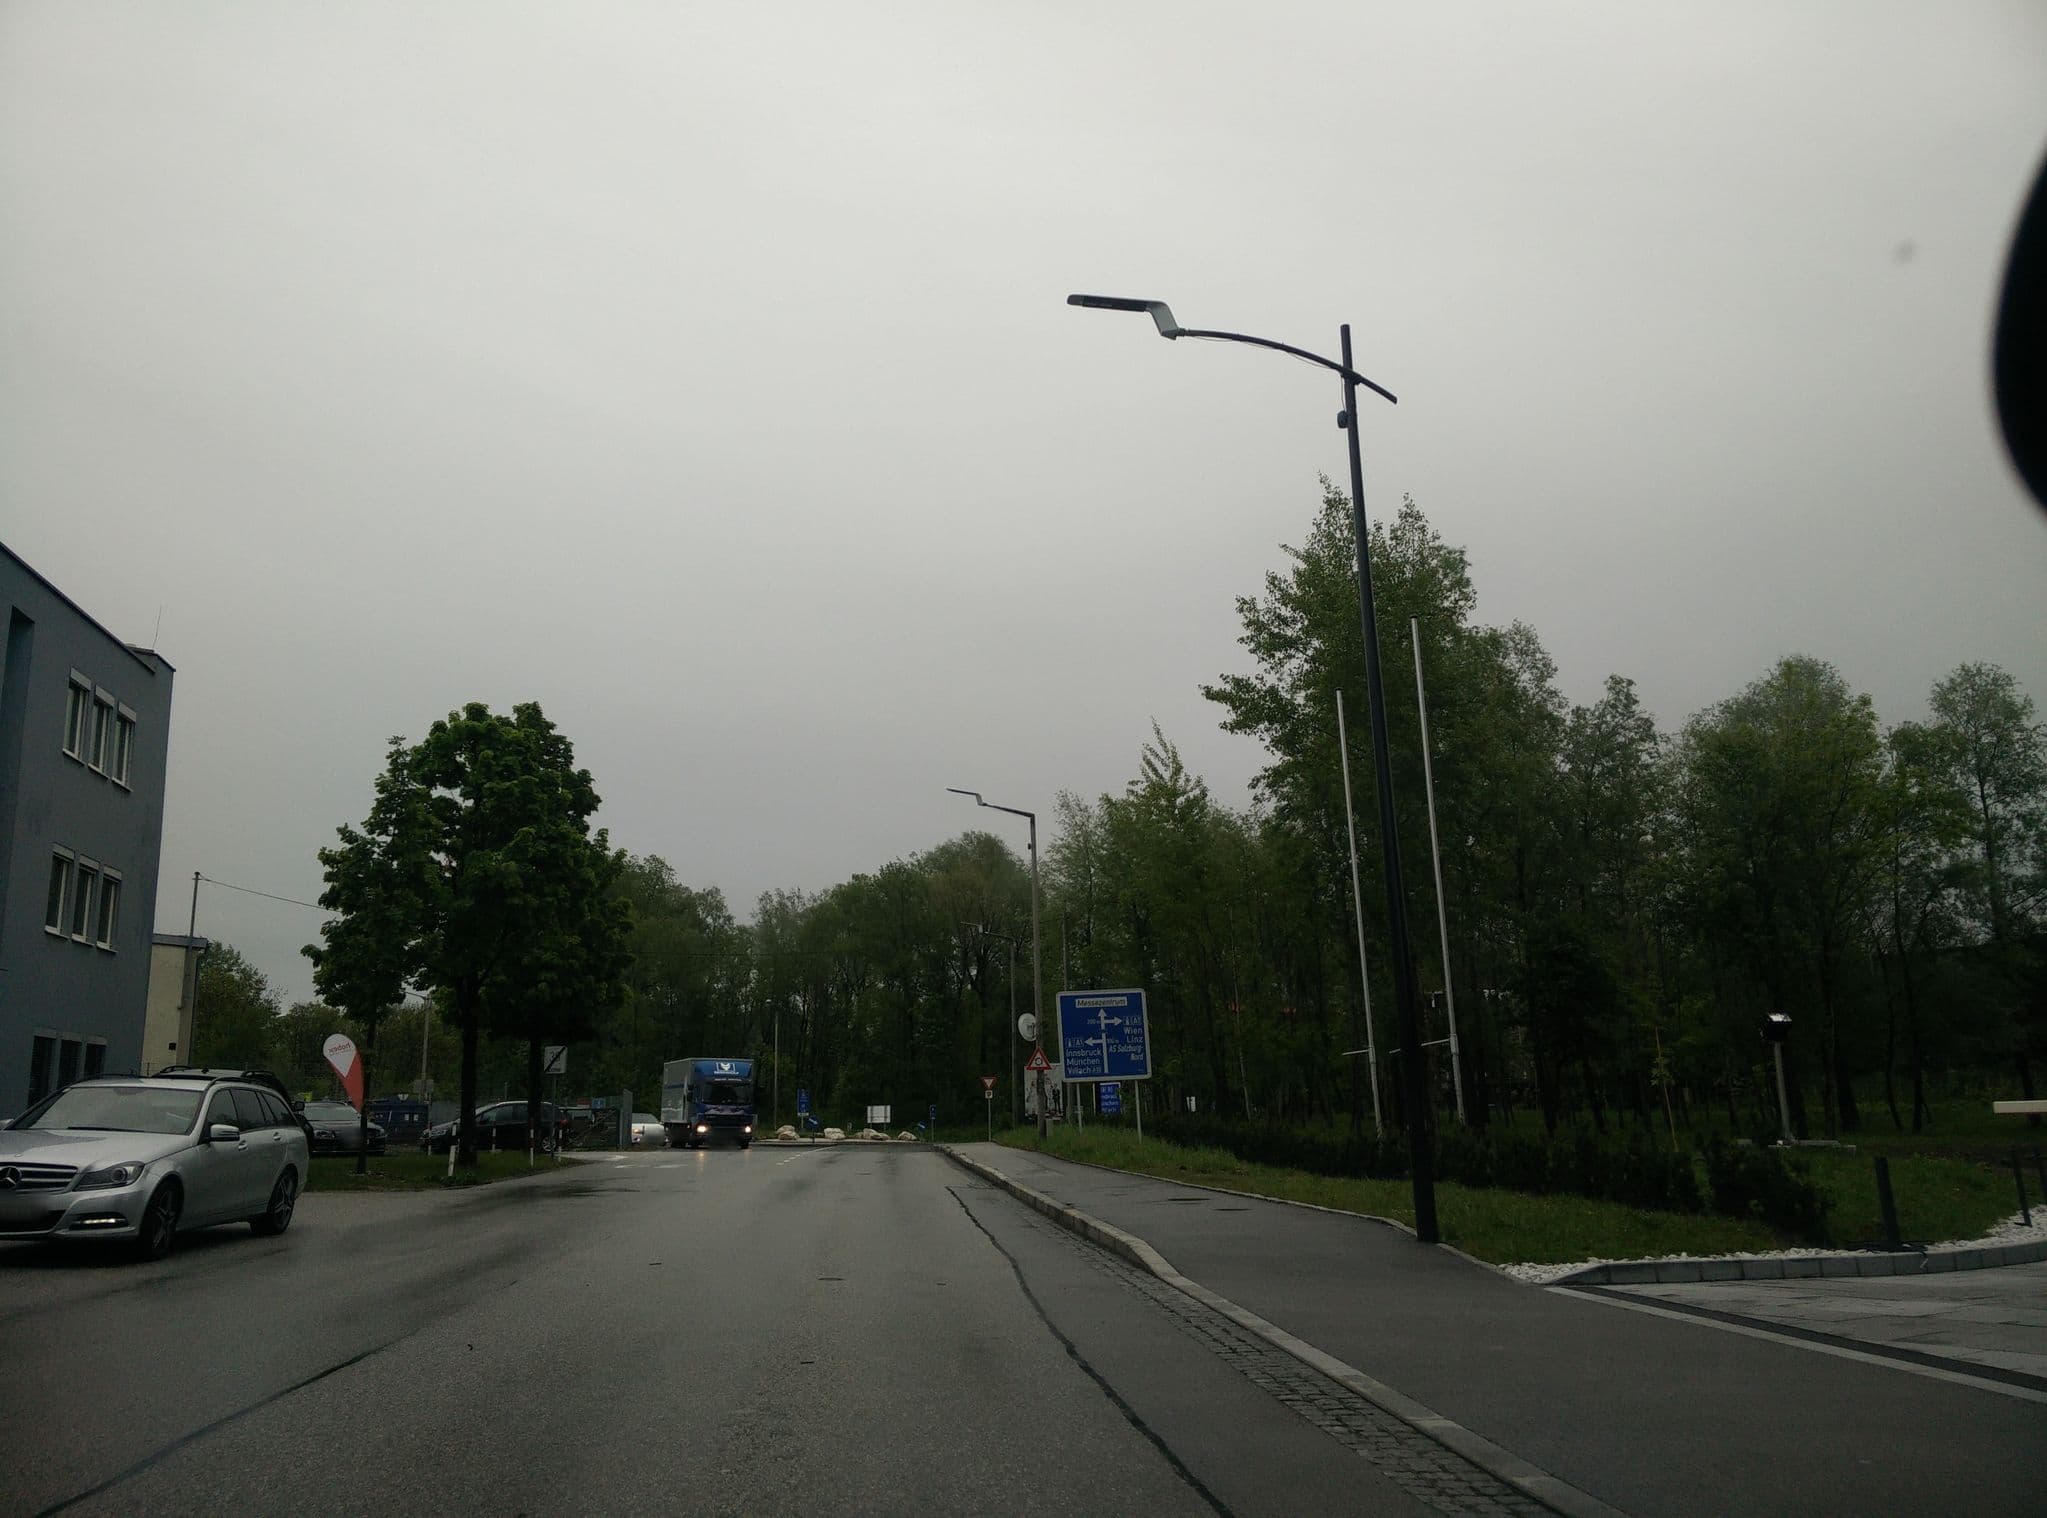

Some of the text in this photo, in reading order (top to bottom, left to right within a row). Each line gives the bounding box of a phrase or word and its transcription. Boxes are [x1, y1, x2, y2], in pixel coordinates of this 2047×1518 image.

[1077, 999, 1125, 1007] Messezentrum
[1124, 1027, 1143, 1035] Wien
[1127, 1035, 1144, 1043] Linz
[1066, 1048, 1102, 1057] Innsbruck
[1066, 1057, 1101, 1066] München
[1067, 1065, 1090, 1075] Villach
